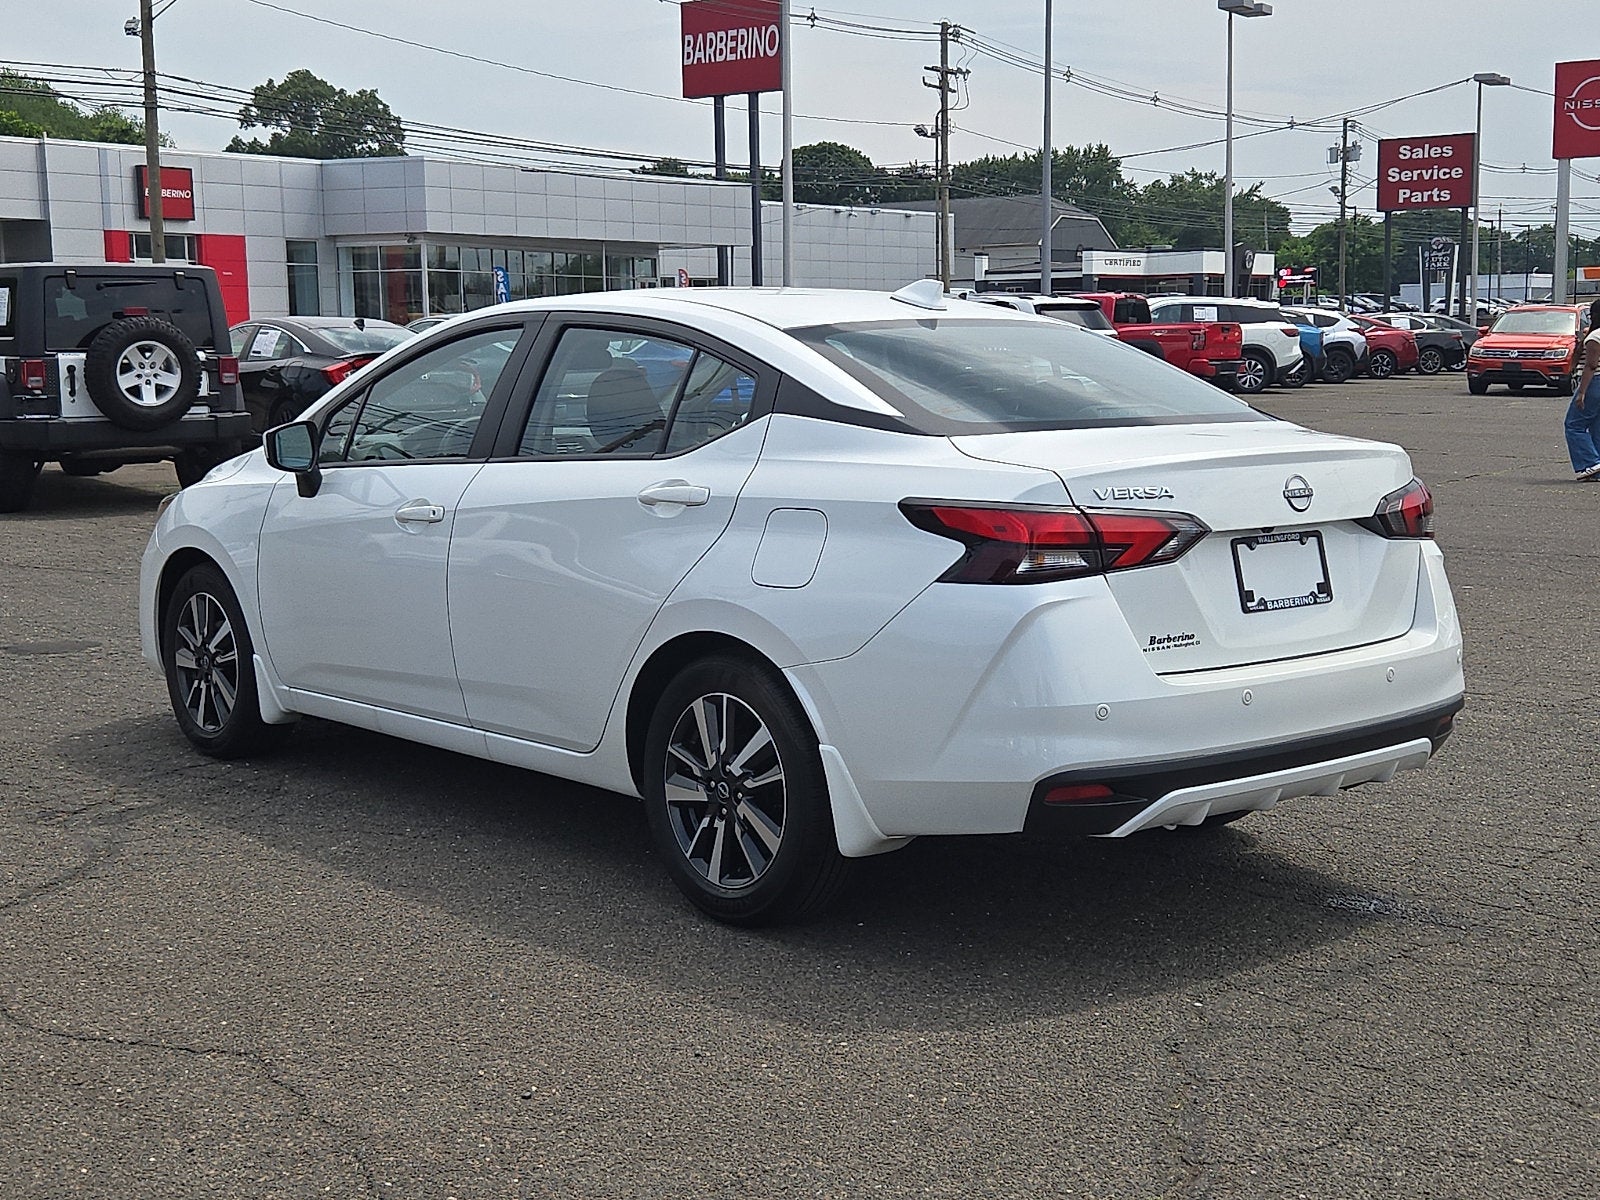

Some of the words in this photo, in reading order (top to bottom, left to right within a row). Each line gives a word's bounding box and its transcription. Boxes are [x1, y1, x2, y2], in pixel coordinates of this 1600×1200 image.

[683, 24, 780, 66] BARBERINO
[1398, 143, 1453, 160] Sales
[1387, 165, 1464, 183] Service
[144, 187, 192, 199] BBERINO
[1397, 187, 1451, 204] Parts
[1104, 258, 1142, 267] CERTIFIED
[1092, 486, 1175, 500] VERSA
[1257, 533, 1300, 543] WALLINGFORD
[1266, 595, 1315, 610] BARBERINO
[1148, 631, 1195, 646] Barberino
[1142, 645, 1171, 653] NISSAN
